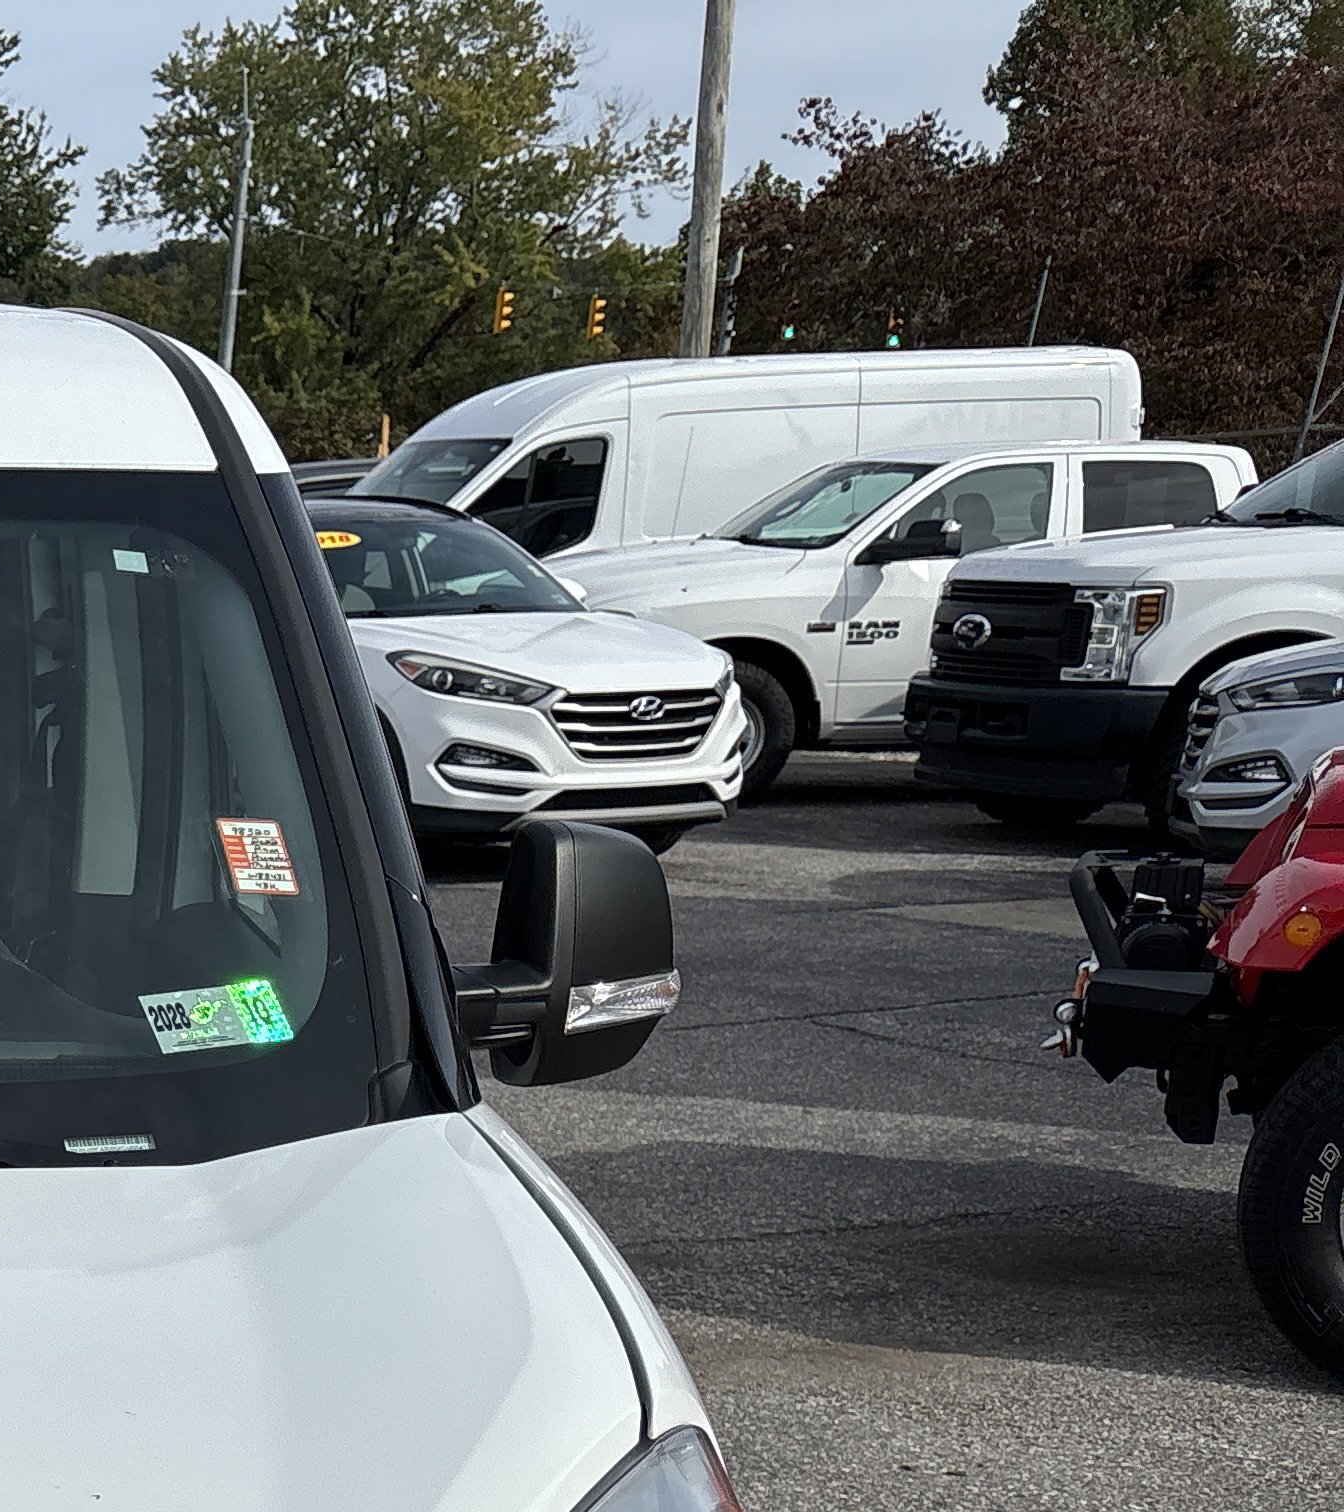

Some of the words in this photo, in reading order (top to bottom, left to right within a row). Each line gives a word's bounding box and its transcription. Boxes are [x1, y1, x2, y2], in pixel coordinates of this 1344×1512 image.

[847, 630, 900, 640] 1500
[848, 620, 901, 630] RAM
[147, 1002, 192, 1033] 2028
[241, 996, 274, 1028] 10
[1301, 1142, 1343, 1225] WILD
